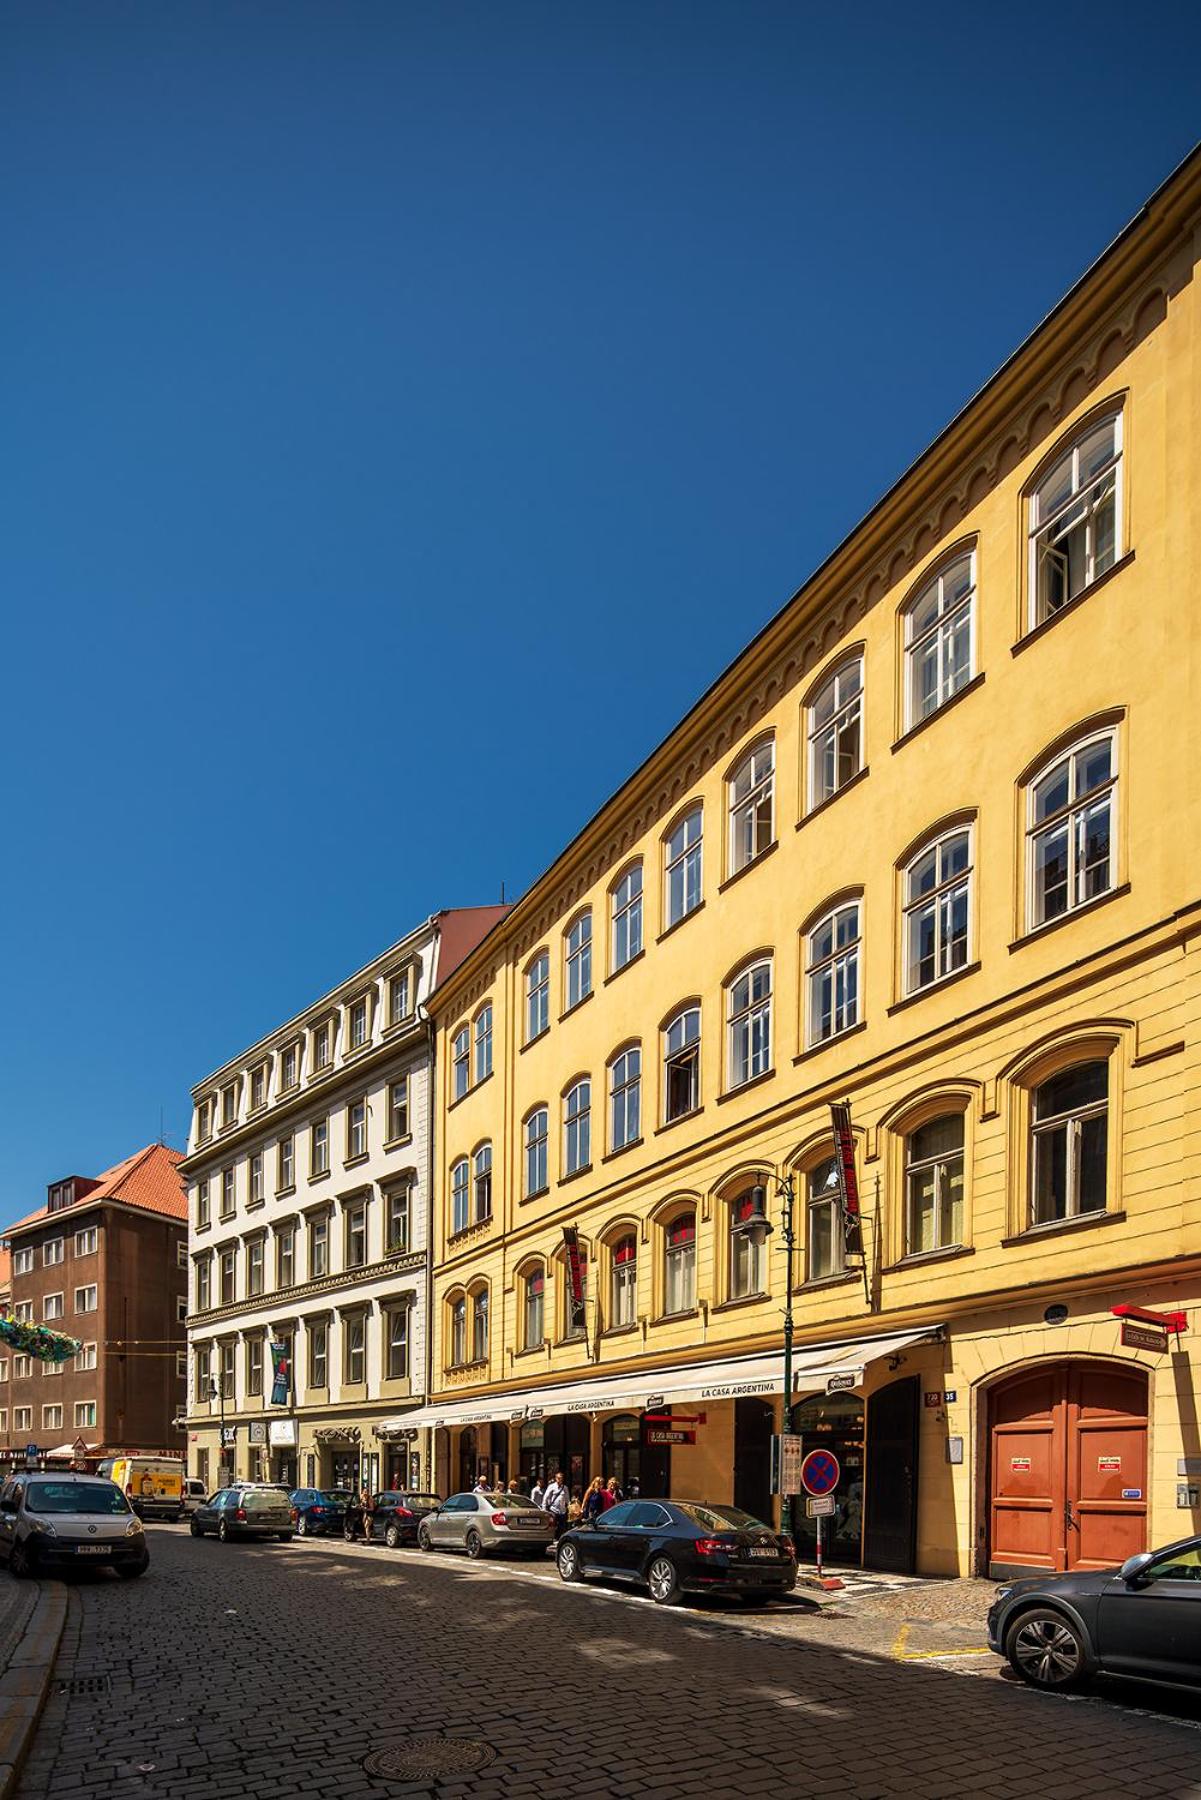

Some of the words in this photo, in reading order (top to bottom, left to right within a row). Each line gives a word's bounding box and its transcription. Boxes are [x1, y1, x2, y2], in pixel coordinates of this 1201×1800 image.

[701, 1390, 711, 1398] LA
[712, 1387, 730, 1396] CASA
[731, 1383, 775, 1395] ARGENTINA
